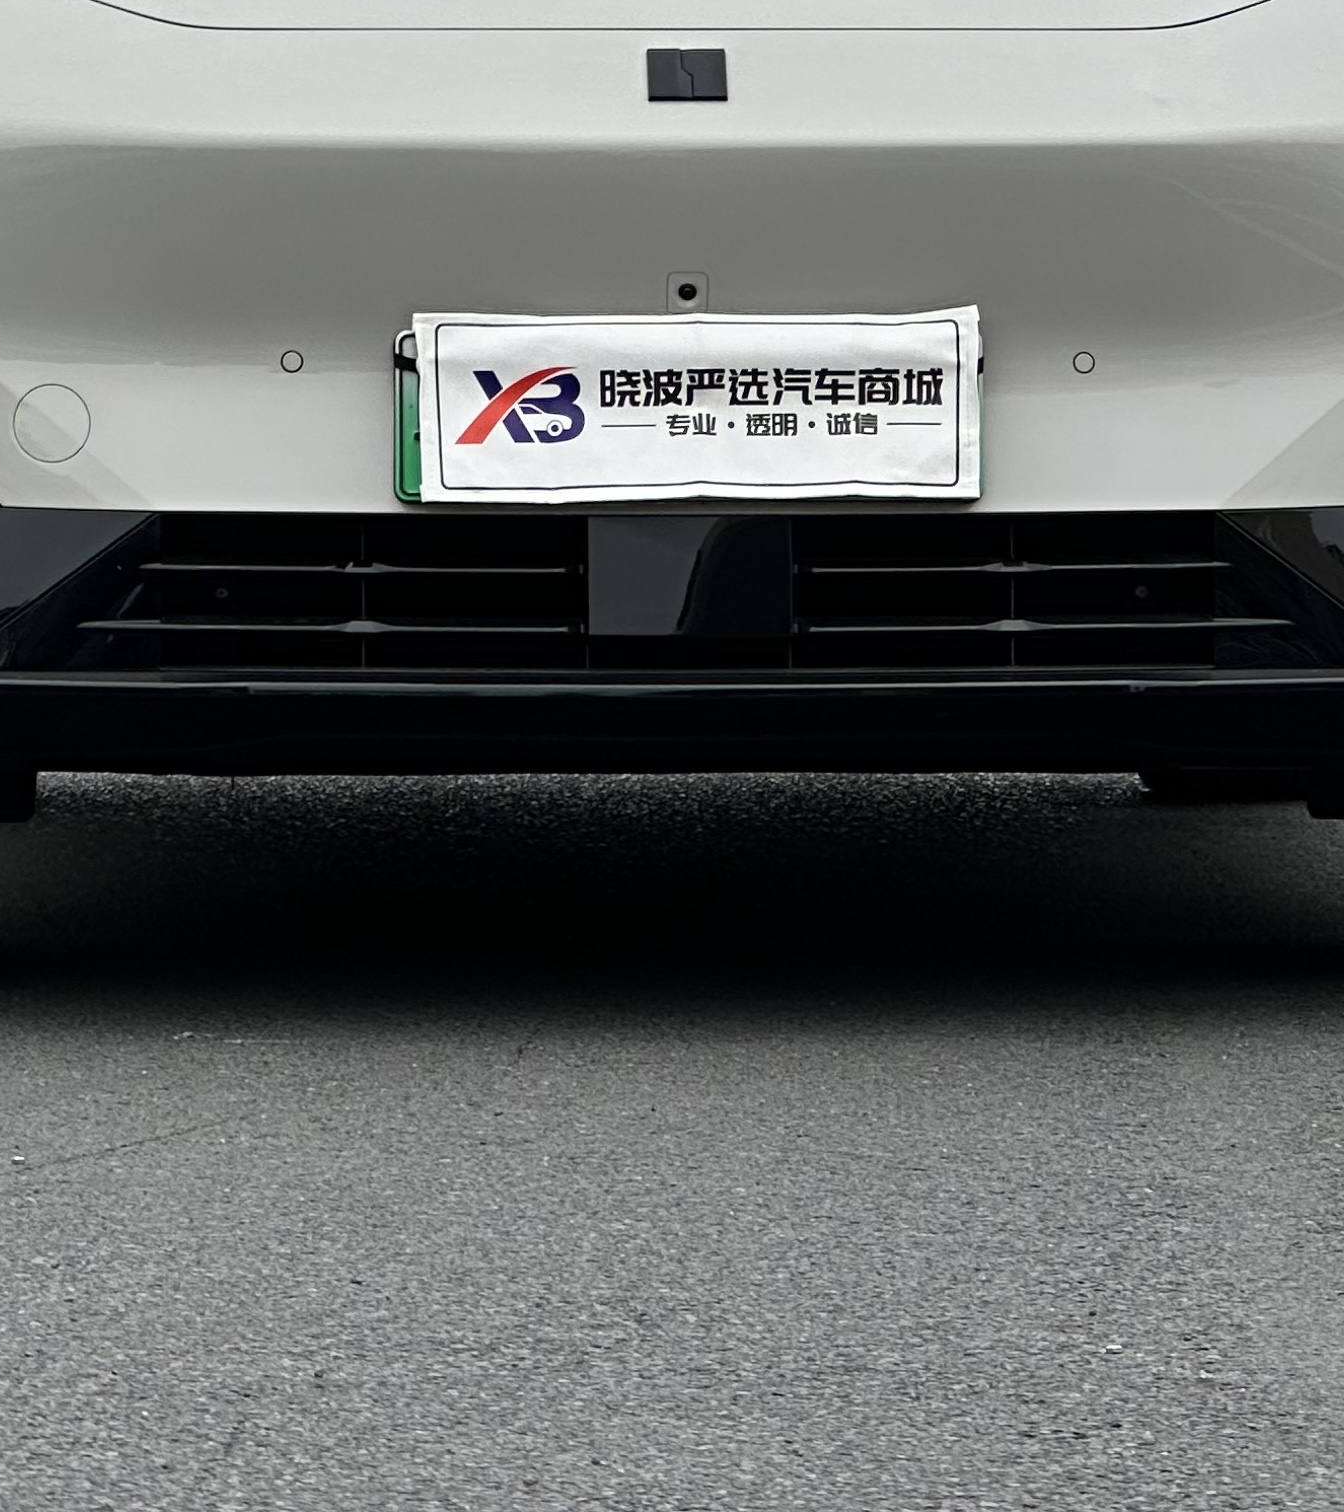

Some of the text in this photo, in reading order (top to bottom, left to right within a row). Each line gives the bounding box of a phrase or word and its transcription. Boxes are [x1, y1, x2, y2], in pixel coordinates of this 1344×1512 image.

[599, 367, 945, 408] 晓波严选汽车商城
